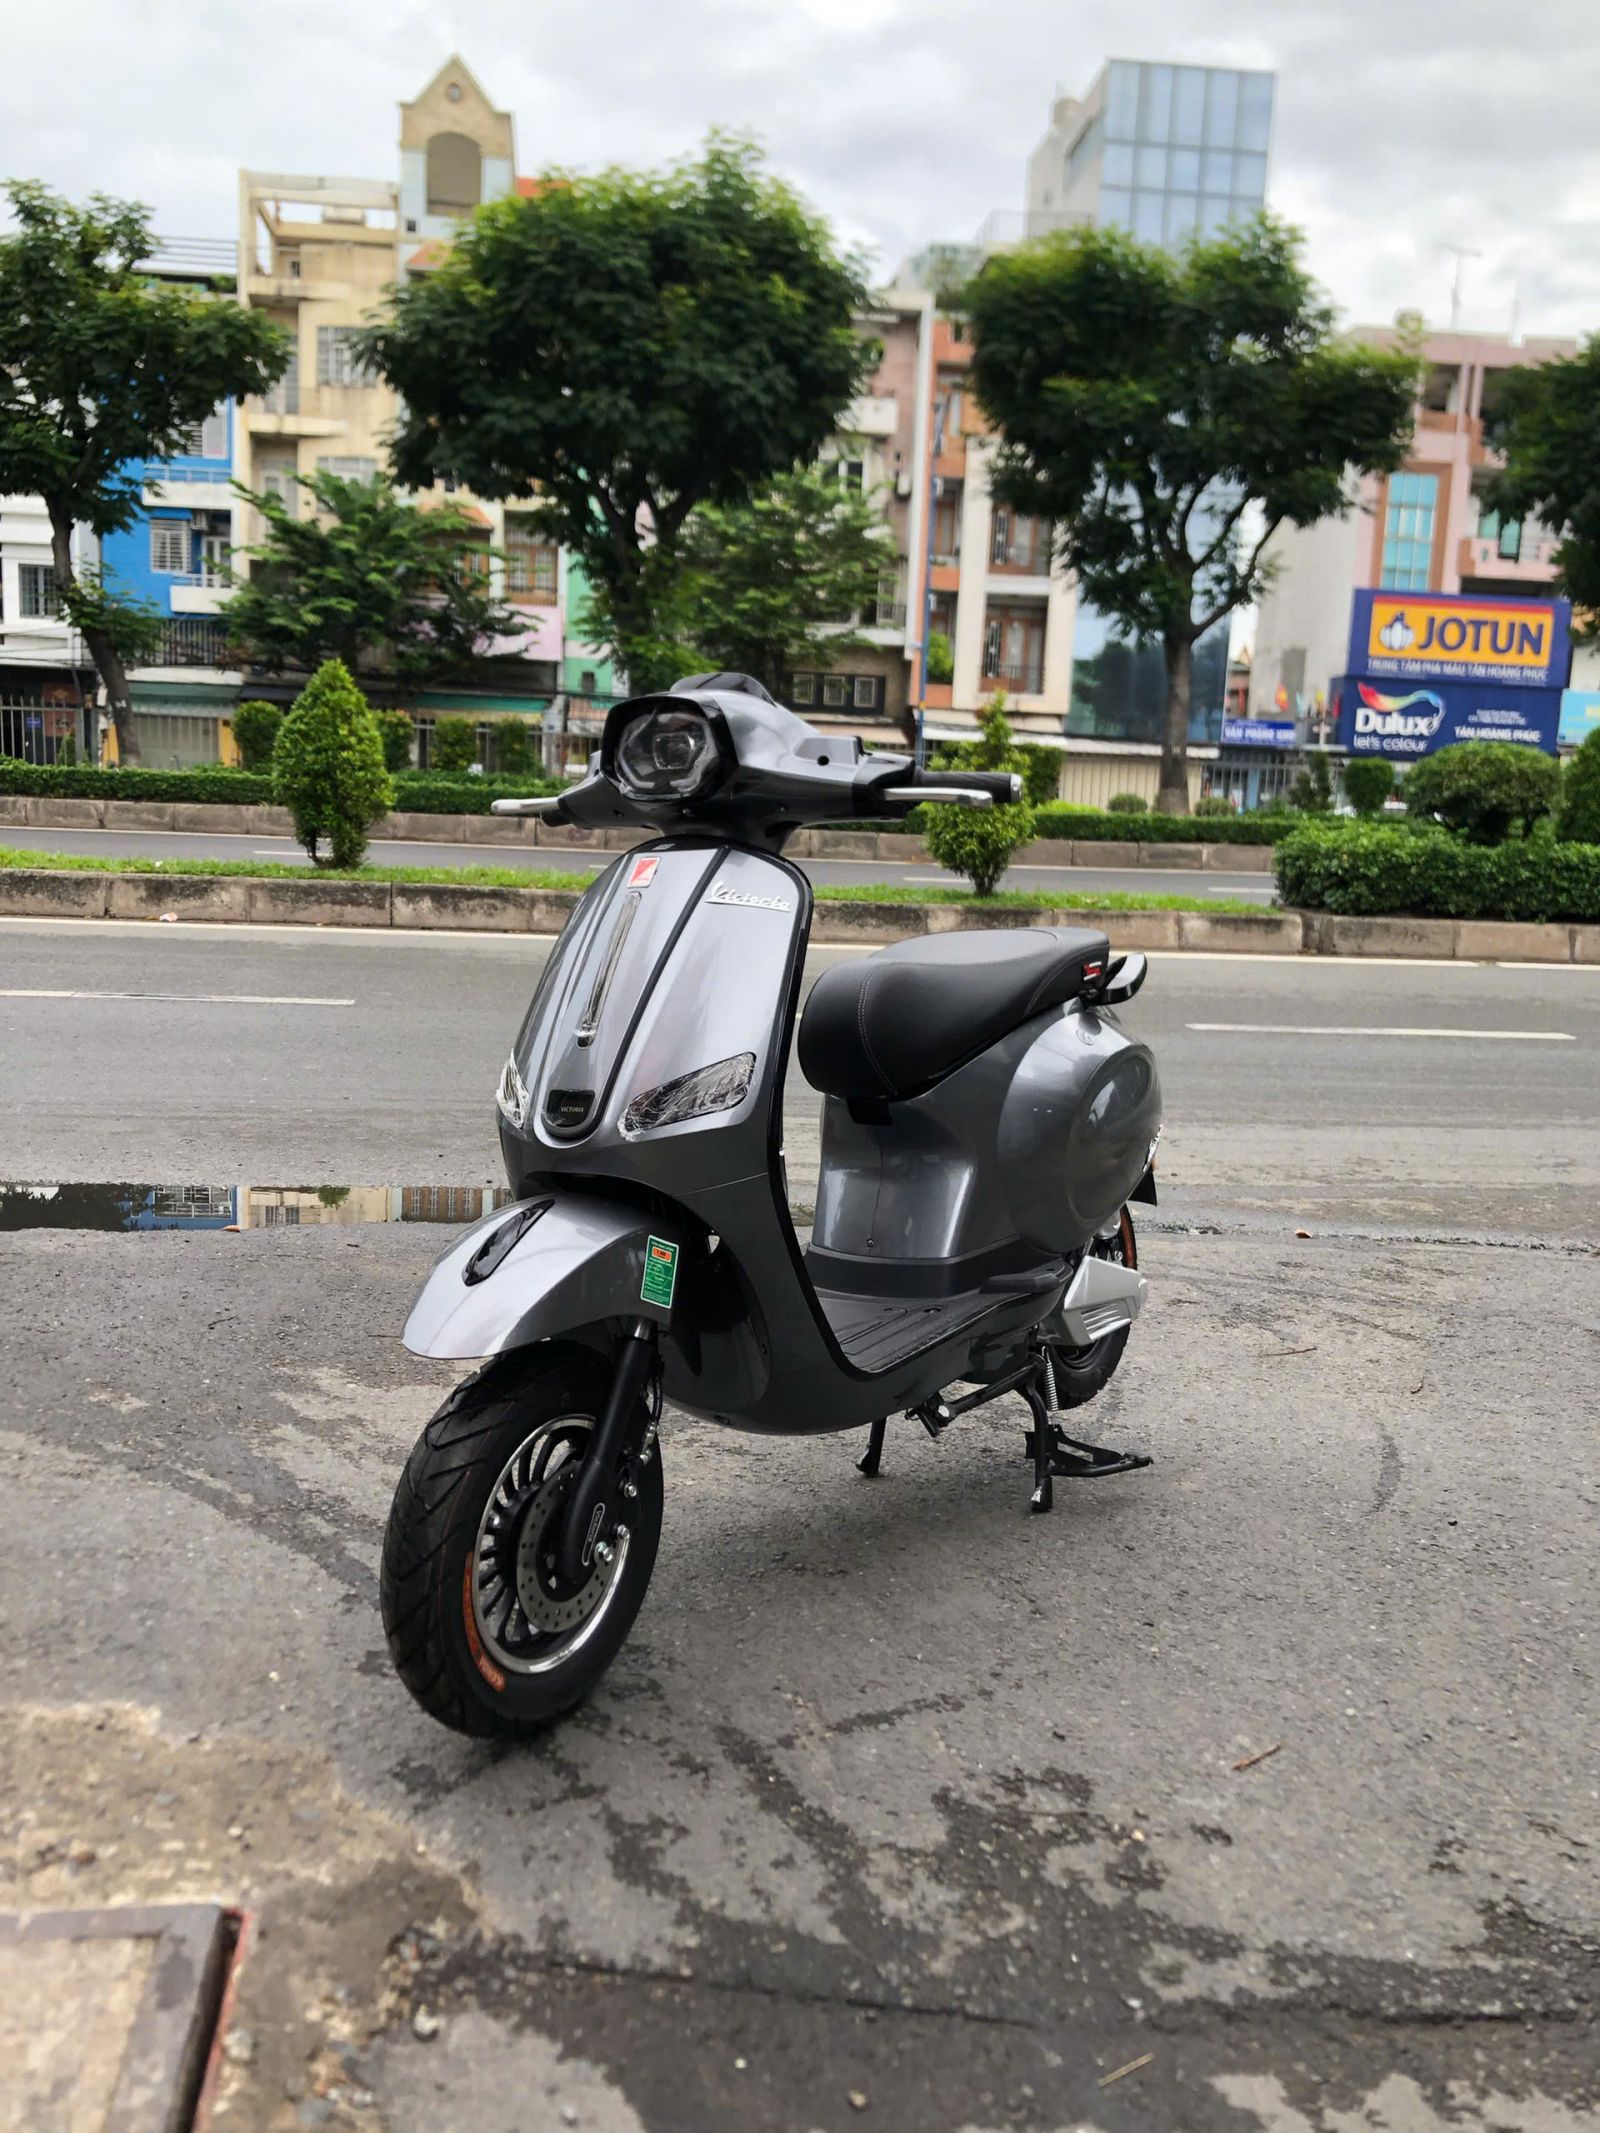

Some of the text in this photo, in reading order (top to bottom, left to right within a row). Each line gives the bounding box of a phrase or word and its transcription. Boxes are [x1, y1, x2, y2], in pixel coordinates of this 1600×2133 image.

[1417, 616, 1544, 656] JOTUN
[1355, 707, 1433, 736] Dulux
[1353, 734, 1428, 752] let's colour
[704, 880, 791, 912] Victoria
